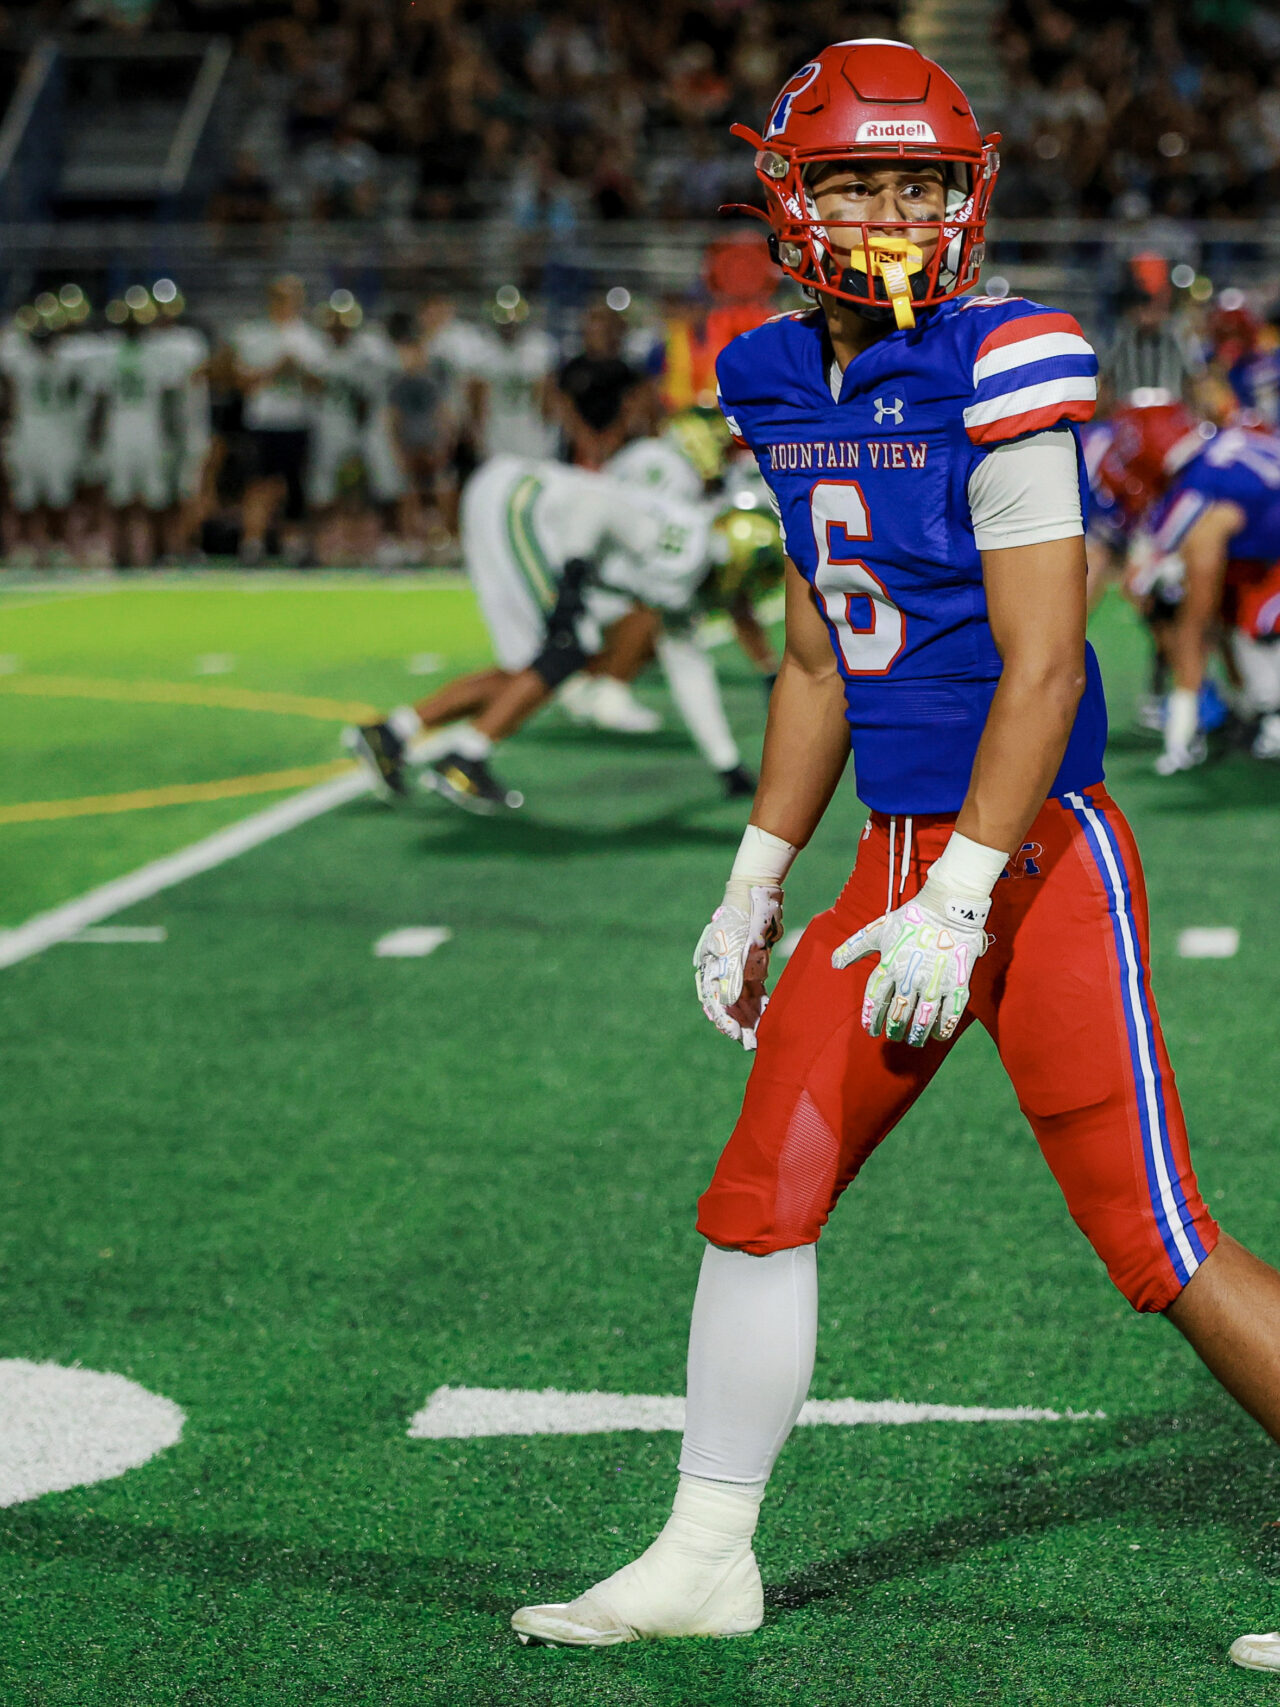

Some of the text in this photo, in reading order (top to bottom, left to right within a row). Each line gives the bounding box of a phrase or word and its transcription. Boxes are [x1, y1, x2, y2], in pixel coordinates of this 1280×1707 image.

[866, 124, 927, 137] Riddell
[785, 197, 826, 239] Ridell
[767, 442, 929, 470] MOUNTAIN VIEW
[809, 479, 907, 676] 6
